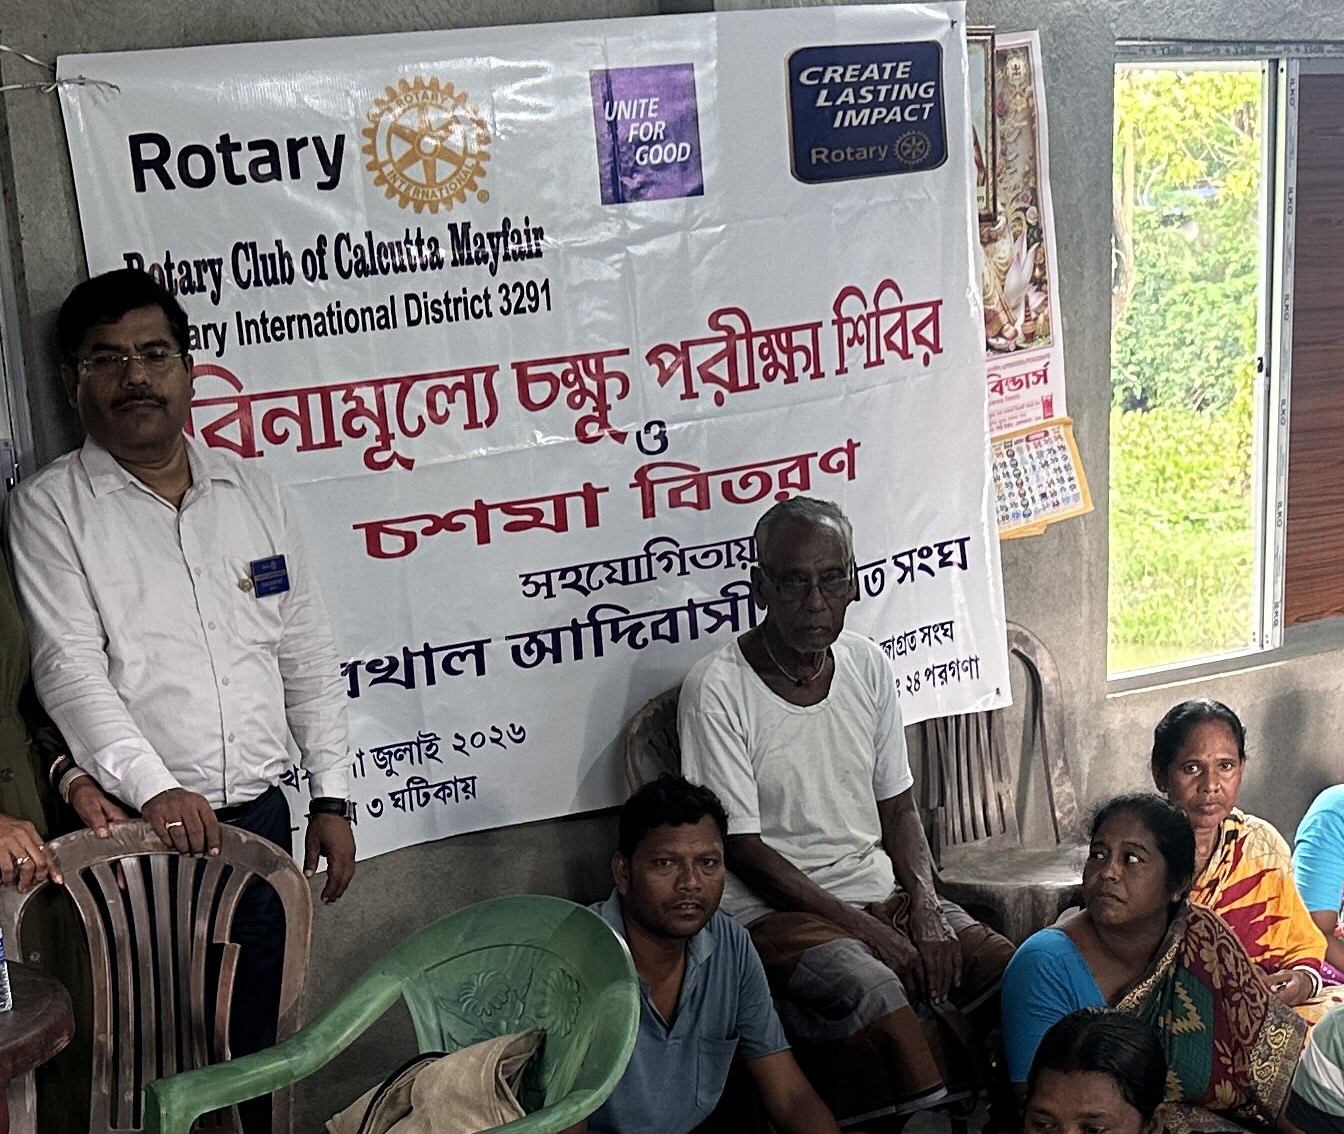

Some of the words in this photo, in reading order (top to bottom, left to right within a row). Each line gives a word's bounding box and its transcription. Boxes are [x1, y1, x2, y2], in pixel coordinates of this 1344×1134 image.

[798, 60, 913, 86] CREATE
[604, 97, 660, 122] UNITE
[816, 81, 936, 108] LASTING
[628, 120, 665, 143] FOR
[833, 102, 935, 129] IMPACT
[128, 129, 346, 193] Rotary
[634, 142, 691, 167] GOOD
[810, 141, 889, 165] Rotary
[386, 162, 475, 201] INTERNATIONAL
[230, 240, 295, 290] Club
[302, 233, 328, 282] of
[334, 225, 444, 278] Calcutta
[448, 216, 545, 277] Mayfair
[188, 321, 227, 358] ary
[236, 294, 398, 347] International
[405, 285, 493, 329] District
[498, 279, 553, 315] 3291
[186, 364, 501, 471] বিনামূল্যে
[510, 348, 631, 445] চক্ষু
[645, 307, 825, 407] পরীক্ষা
[831, 279, 944, 377] শিবির
[636, 420, 668, 455] ও
[353, 482, 609, 559] চশমা
[630, 439, 861, 520] বিতরণ
[893, 535, 971, 585] সংঘ
[505, 580, 759, 672] আদিবাসী
[919, 620, 954, 647] সংঘ
[906, 670, 921, 697] ২৪
[924, 654, 980, 688] পরগণা
[369, 730, 444, 778] জুলাই
[452, 722, 527, 757] ২০২৬
[367, 798, 384, 818] ৩
[388, 775, 478, 814] ঘটিকায়
